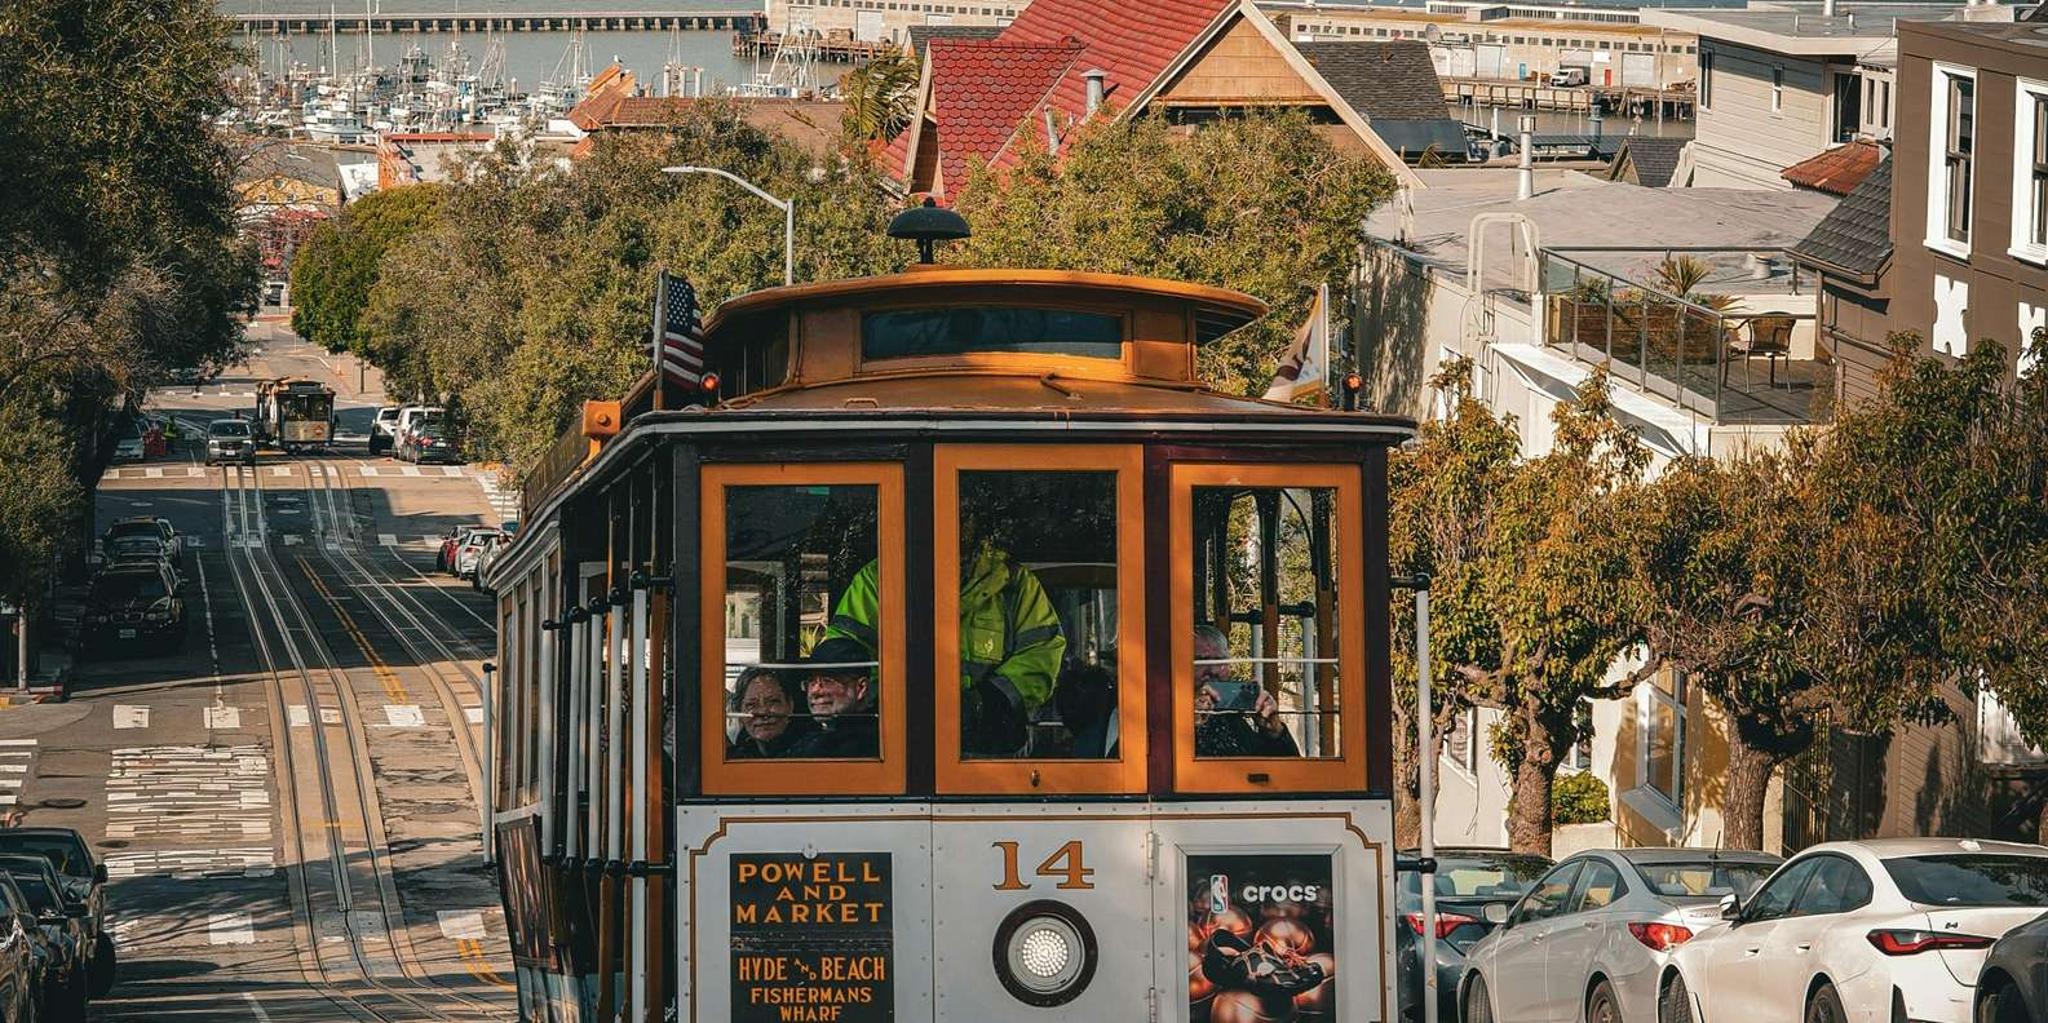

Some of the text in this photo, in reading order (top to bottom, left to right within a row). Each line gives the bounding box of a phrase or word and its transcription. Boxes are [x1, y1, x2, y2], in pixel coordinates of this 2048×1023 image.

[738, 862, 881, 883] POWELL
[992, 840, 1095, 890] 14
[777, 885, 847, 901] AND
[1242, 885, 1317, 902] crocs
[735, 903, 884, 924] MARKET
[738, 957, 885, 981] HYDE AND BEACH
[750, 987, 872, 1004] FISHERMANS
[780, 1006, 842, 1022] WHARF
